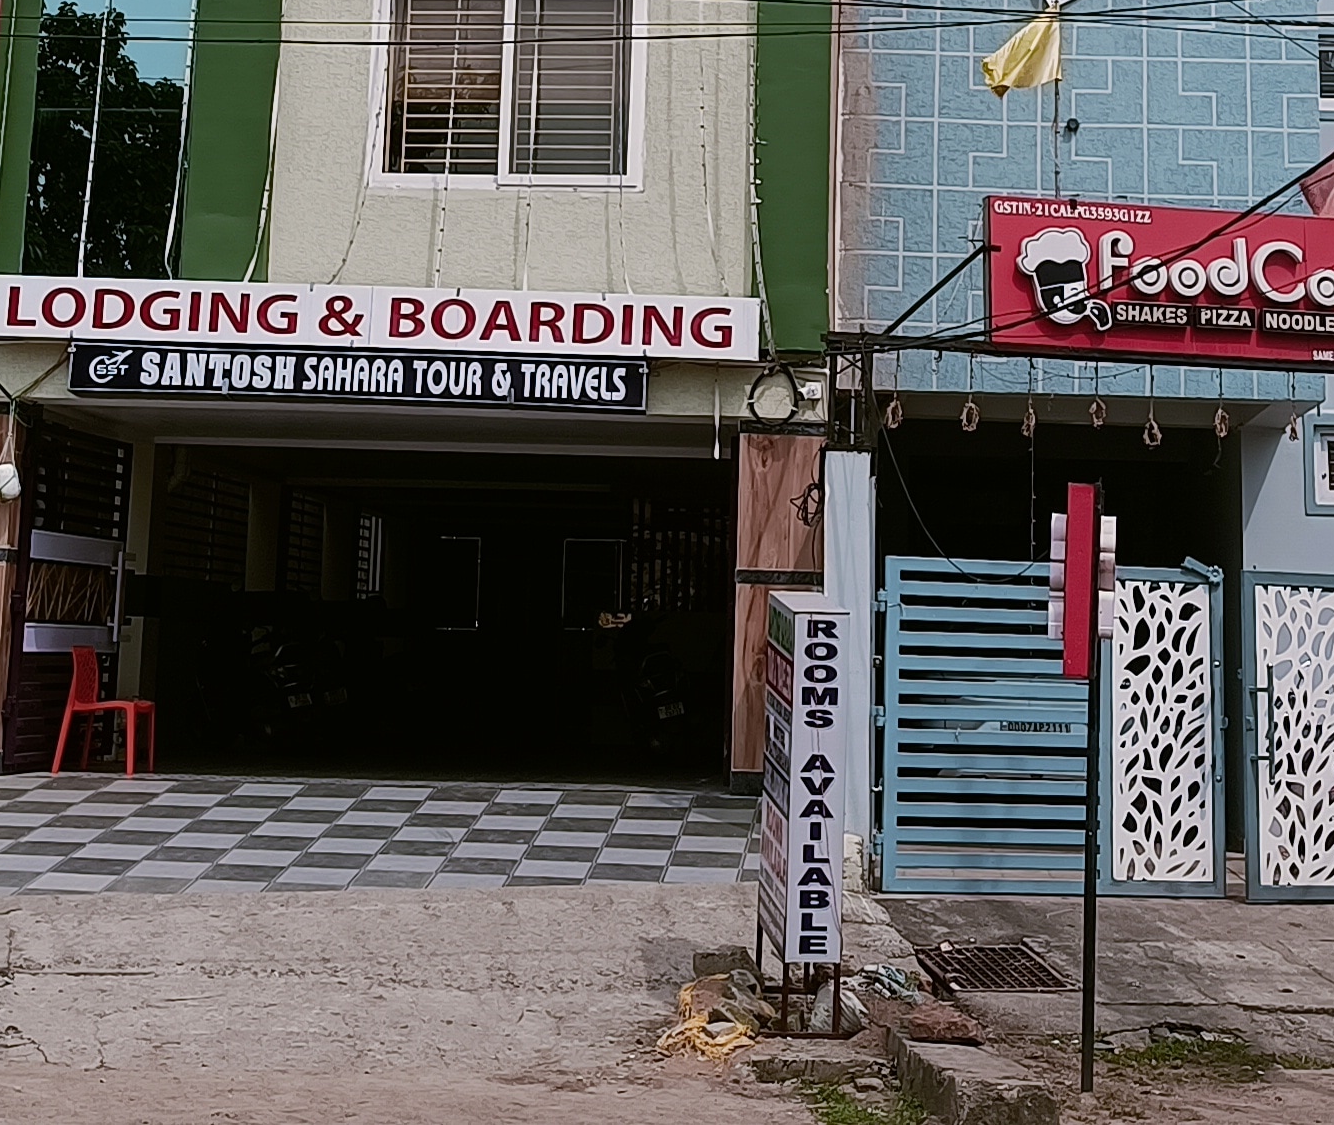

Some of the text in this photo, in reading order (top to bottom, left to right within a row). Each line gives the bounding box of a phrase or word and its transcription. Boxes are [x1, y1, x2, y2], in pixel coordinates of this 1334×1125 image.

[7, 286, 733, 349] LODGING & BOARDING
[1116, 305, 1188, 324] SHAKES
[1200, 309, 1252, 326] PIZZA
[96, 364, 129, 375] SST
[140, 351, 627, 401] SANTOSH SAHARA TOUR & TRAVELS
[801, 619, 839, 729] ROOMS
[797, 753, 835, 956] AVAILABLE
